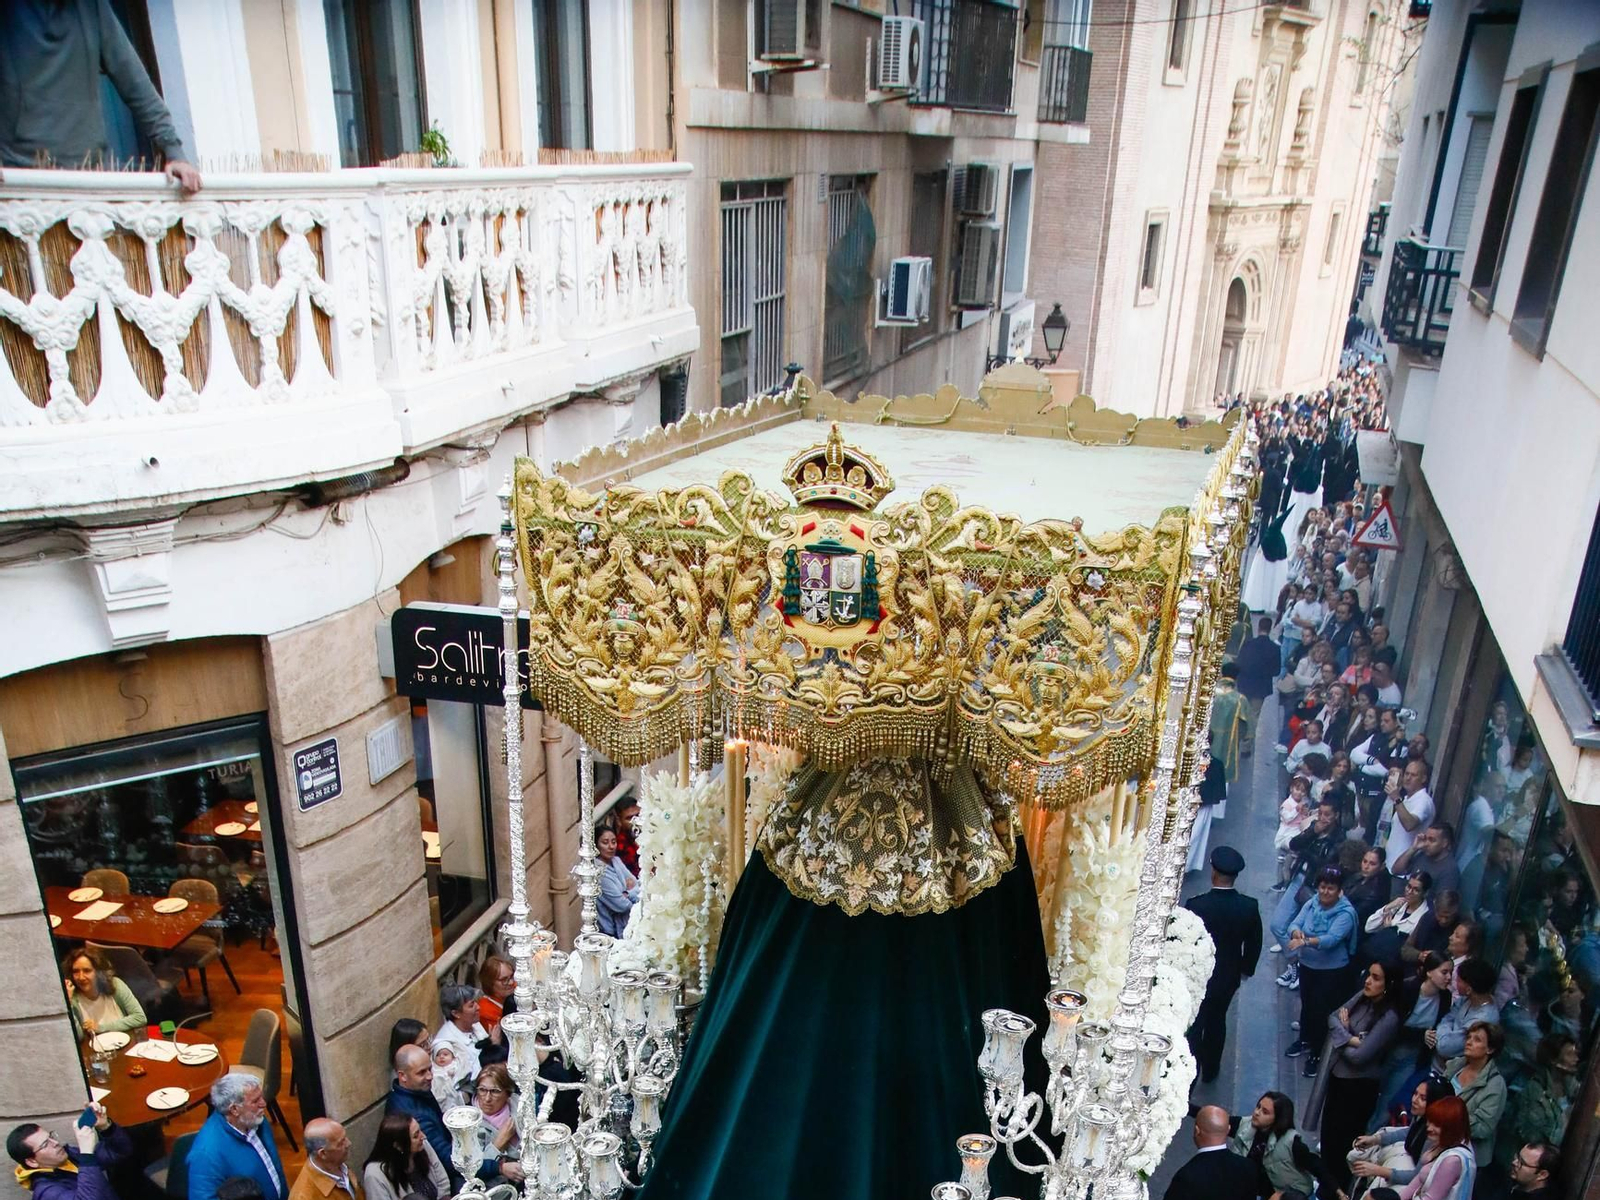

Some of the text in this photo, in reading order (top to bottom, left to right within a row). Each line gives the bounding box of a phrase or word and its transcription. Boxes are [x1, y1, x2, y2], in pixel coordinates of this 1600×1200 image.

[416, 671, 528, 692] bardevio
[207, 760, 252, 780] TURIA
[303, 793, 315, 803] 902
